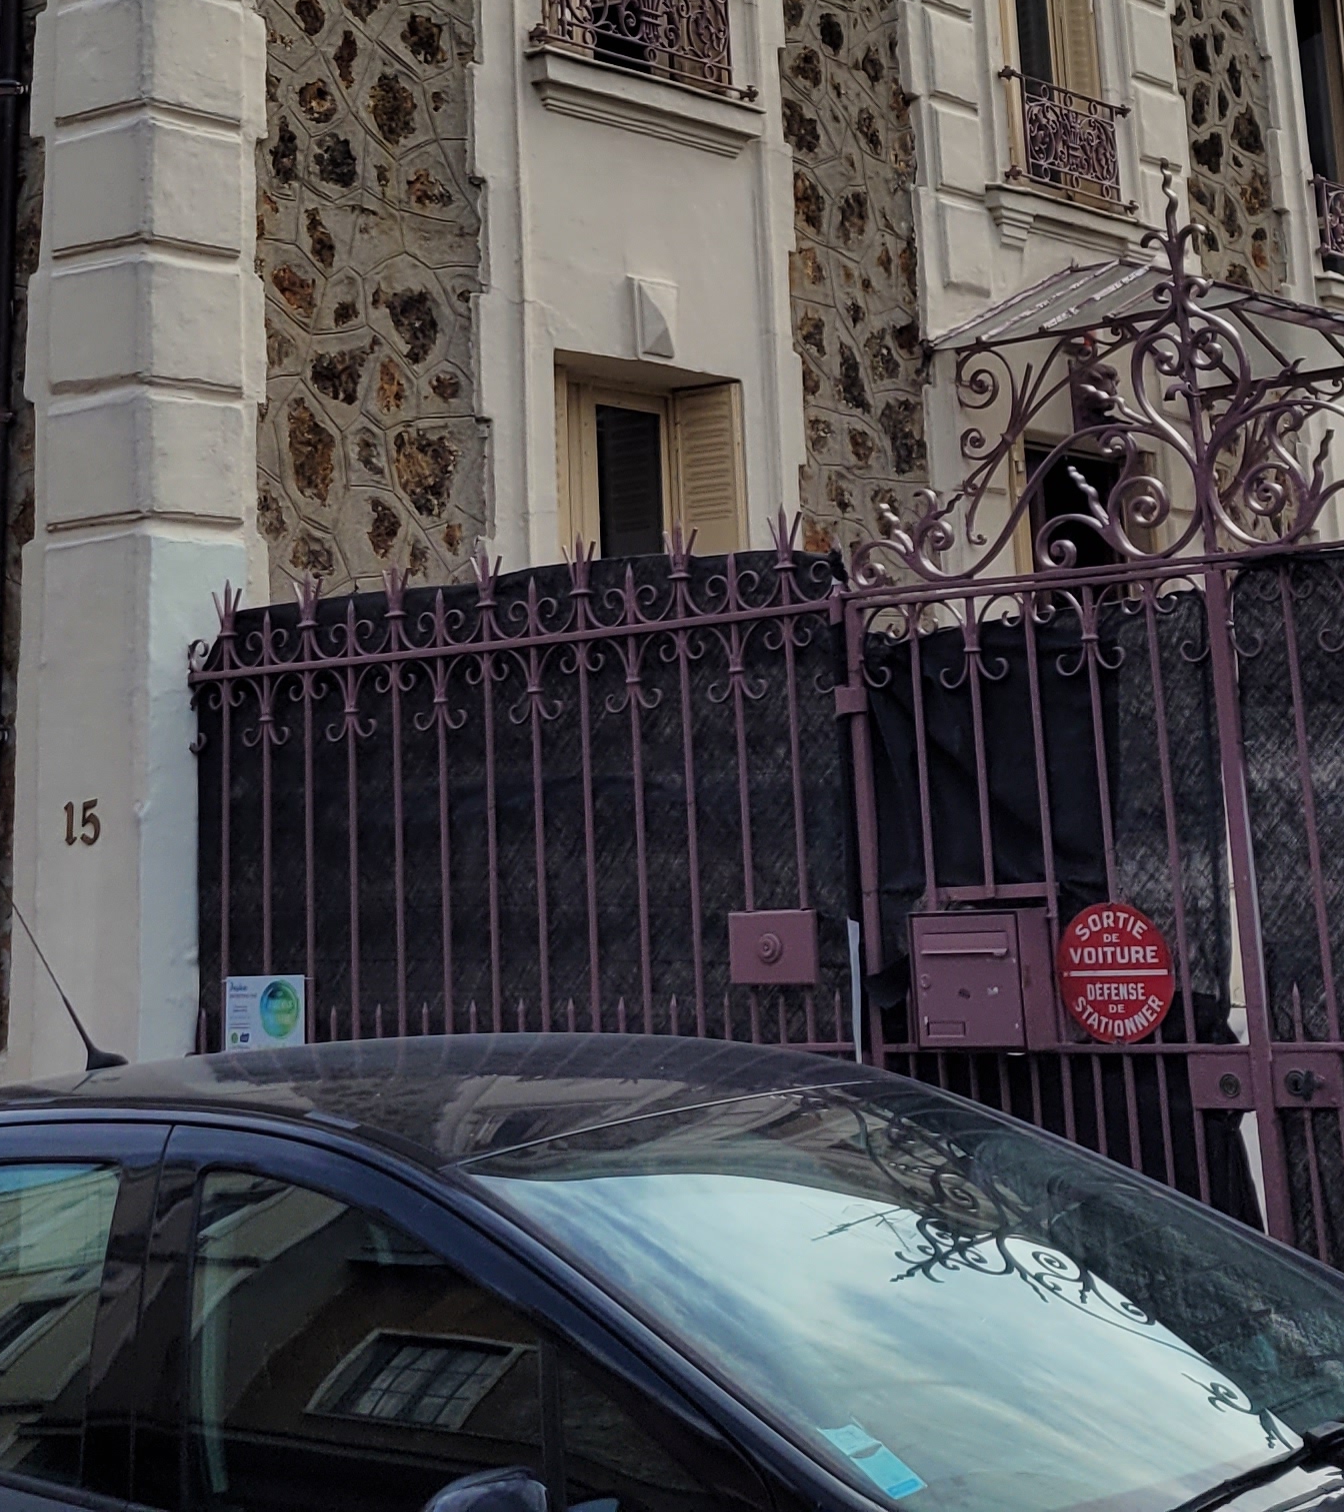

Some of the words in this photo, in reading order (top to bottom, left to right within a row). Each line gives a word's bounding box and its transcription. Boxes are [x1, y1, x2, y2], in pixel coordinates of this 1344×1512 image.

[64, 799, 100, 846] 15
[1076, 912, 1148, 941] SORTIE
[1104, 934, 1120, 942] DE
[1070, 946, 1158, 964] VOITURE
[1087, 982, 1146, 1000] DÉFENSE
[1075, 995, 1164, 1036] STATIONNER
[1109, 1004, 1125, 1013] DE
